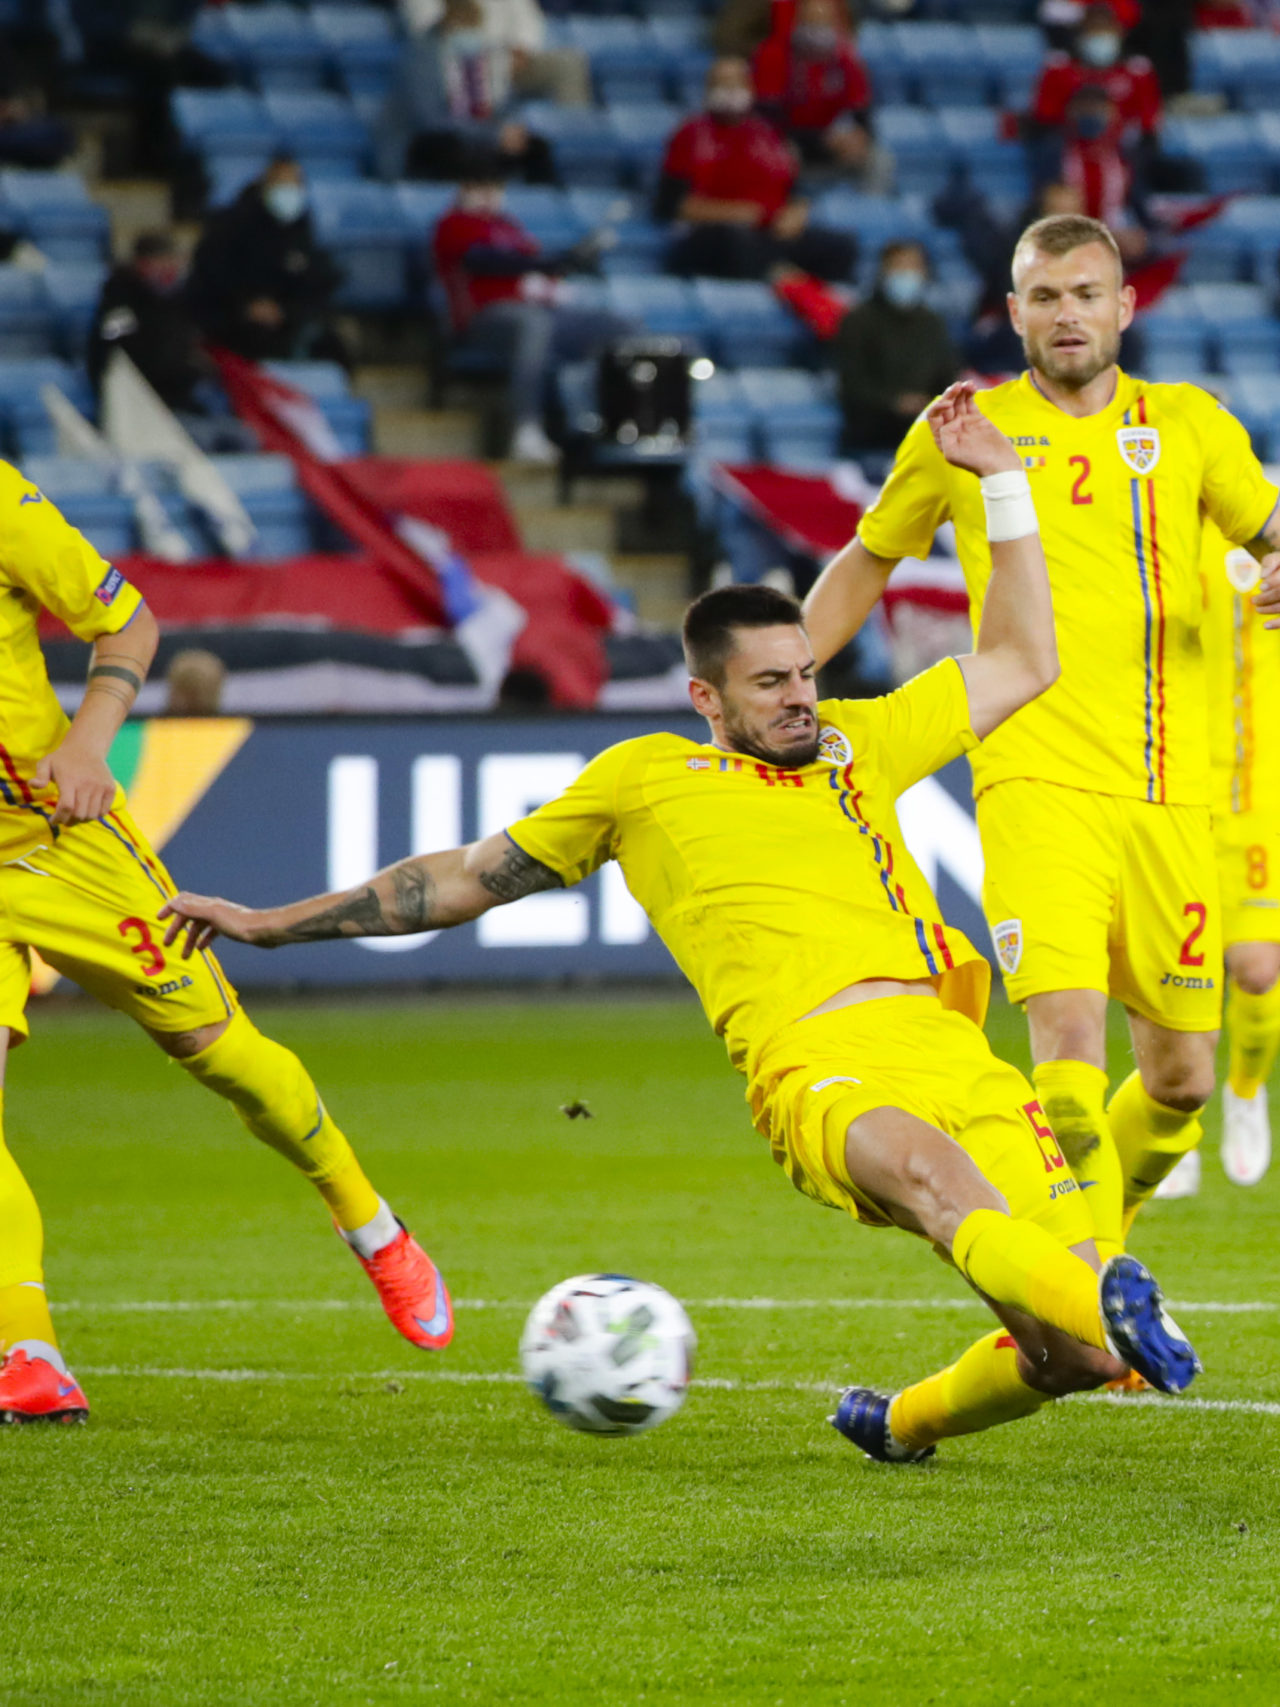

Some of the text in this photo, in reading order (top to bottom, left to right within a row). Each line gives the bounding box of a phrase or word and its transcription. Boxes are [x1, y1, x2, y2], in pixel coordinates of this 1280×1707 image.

[1069, 455, 1093, 505] 2
[328, 753, 650, 950] UE
[1246, 845, 1269, 890] 8
[118, 916, 165, 977] 3
[1179, 902, 1207, 967] 2
[1160, 972, 1214, 989] Joma
[1015, 1099, 1065, 1174] 5
